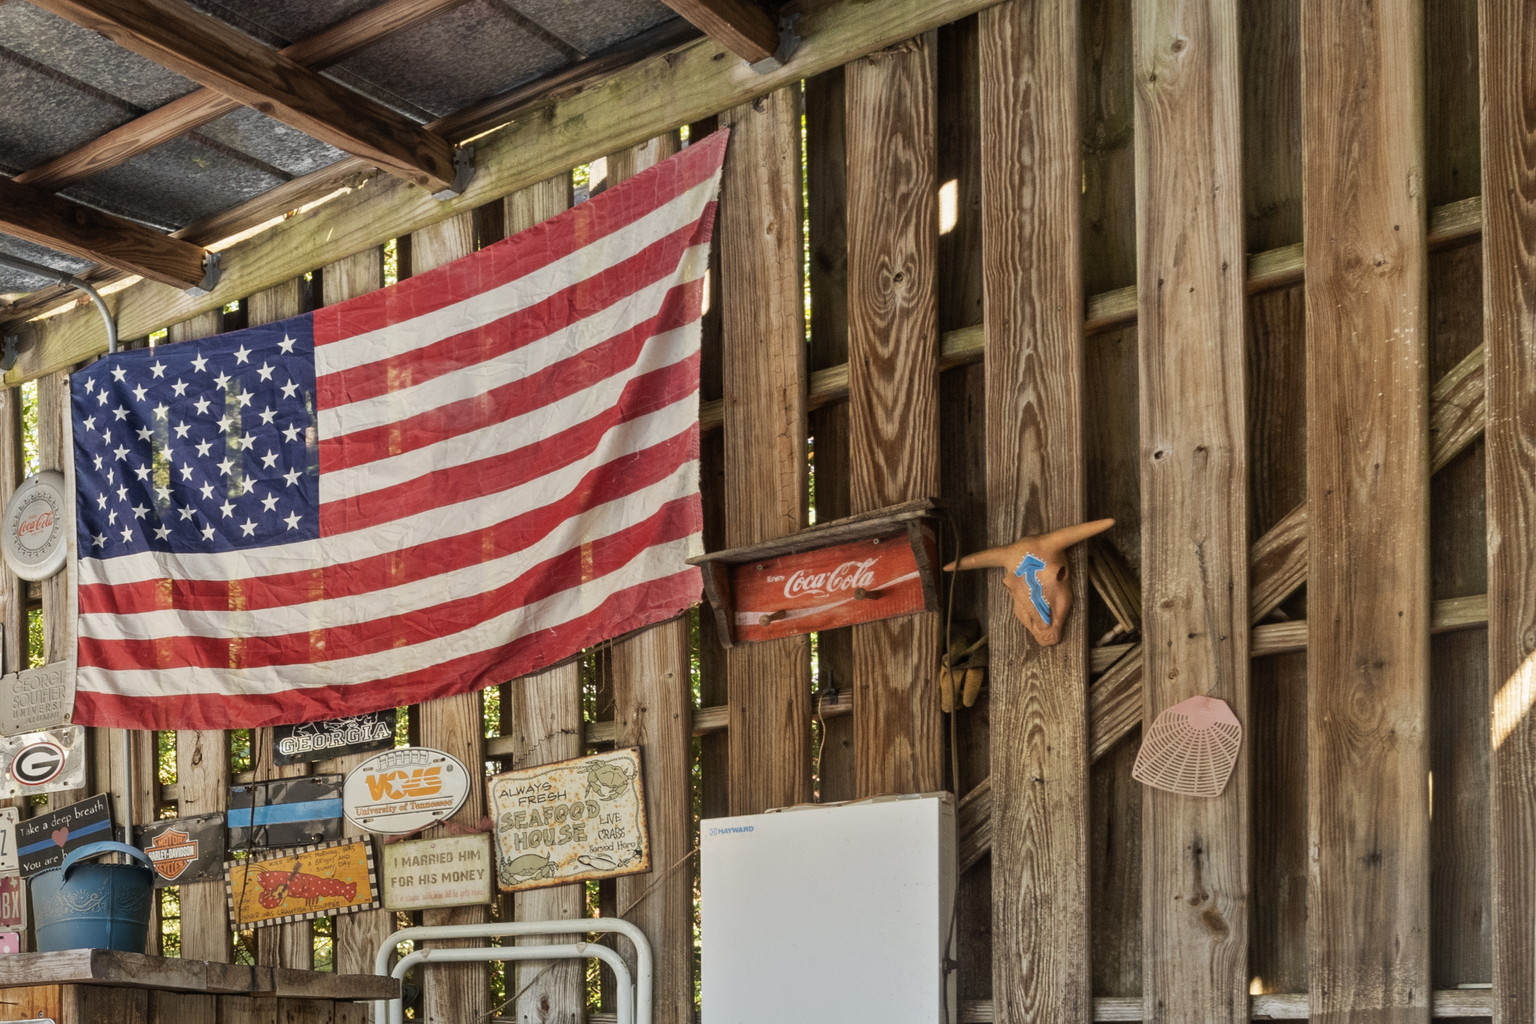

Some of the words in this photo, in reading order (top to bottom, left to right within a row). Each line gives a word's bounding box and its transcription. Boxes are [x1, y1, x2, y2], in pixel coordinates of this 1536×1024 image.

[18, 511, 54, 537] Coca-Cola
[784, 556, 882, 598] Coca-Cola
[279, 721, 392, 756] GEORGIA
[15, 744, 63, 782] G
[499, 782, 552, 799] ALWAYS
[518, 790, 567, 807] FRESH
[355, 805, 398, 817] University
[399, 803, 408, 812] of
[410, 799, 453, 811] Tennessee
[499, 800, 601, 833] SEAFOOD
[20, 825, 40, 837] Take
[42, 823, 48, 831] a
[51, 815, 72, 827] deep
[74, 800, 104, 819] breath
[599, 812, 622, 826] LIVE
[514, 823, 588, 851] HOUSE
[718, 825, 754, 834] HAYWARD
[155, 833, 187, 847] MOTOR
[148, 845, 195, 861] HARLEY-DAVIDSON
[315, 857, 335, 866] BRIGHT
[393, 857, 397, 869] I
[401, 853, 453, 868] MARRIED
[458, 850, 481, 862] HIM
[23, 861, 42, 872] You
[44, 856, 59, 865] are
[391, 875, 414, 889] FOR
[418, 872, 437, 885] HIS
[442, 868, 485, 883] MONEY
[276, 906, 307, 916] CRAWFISH
